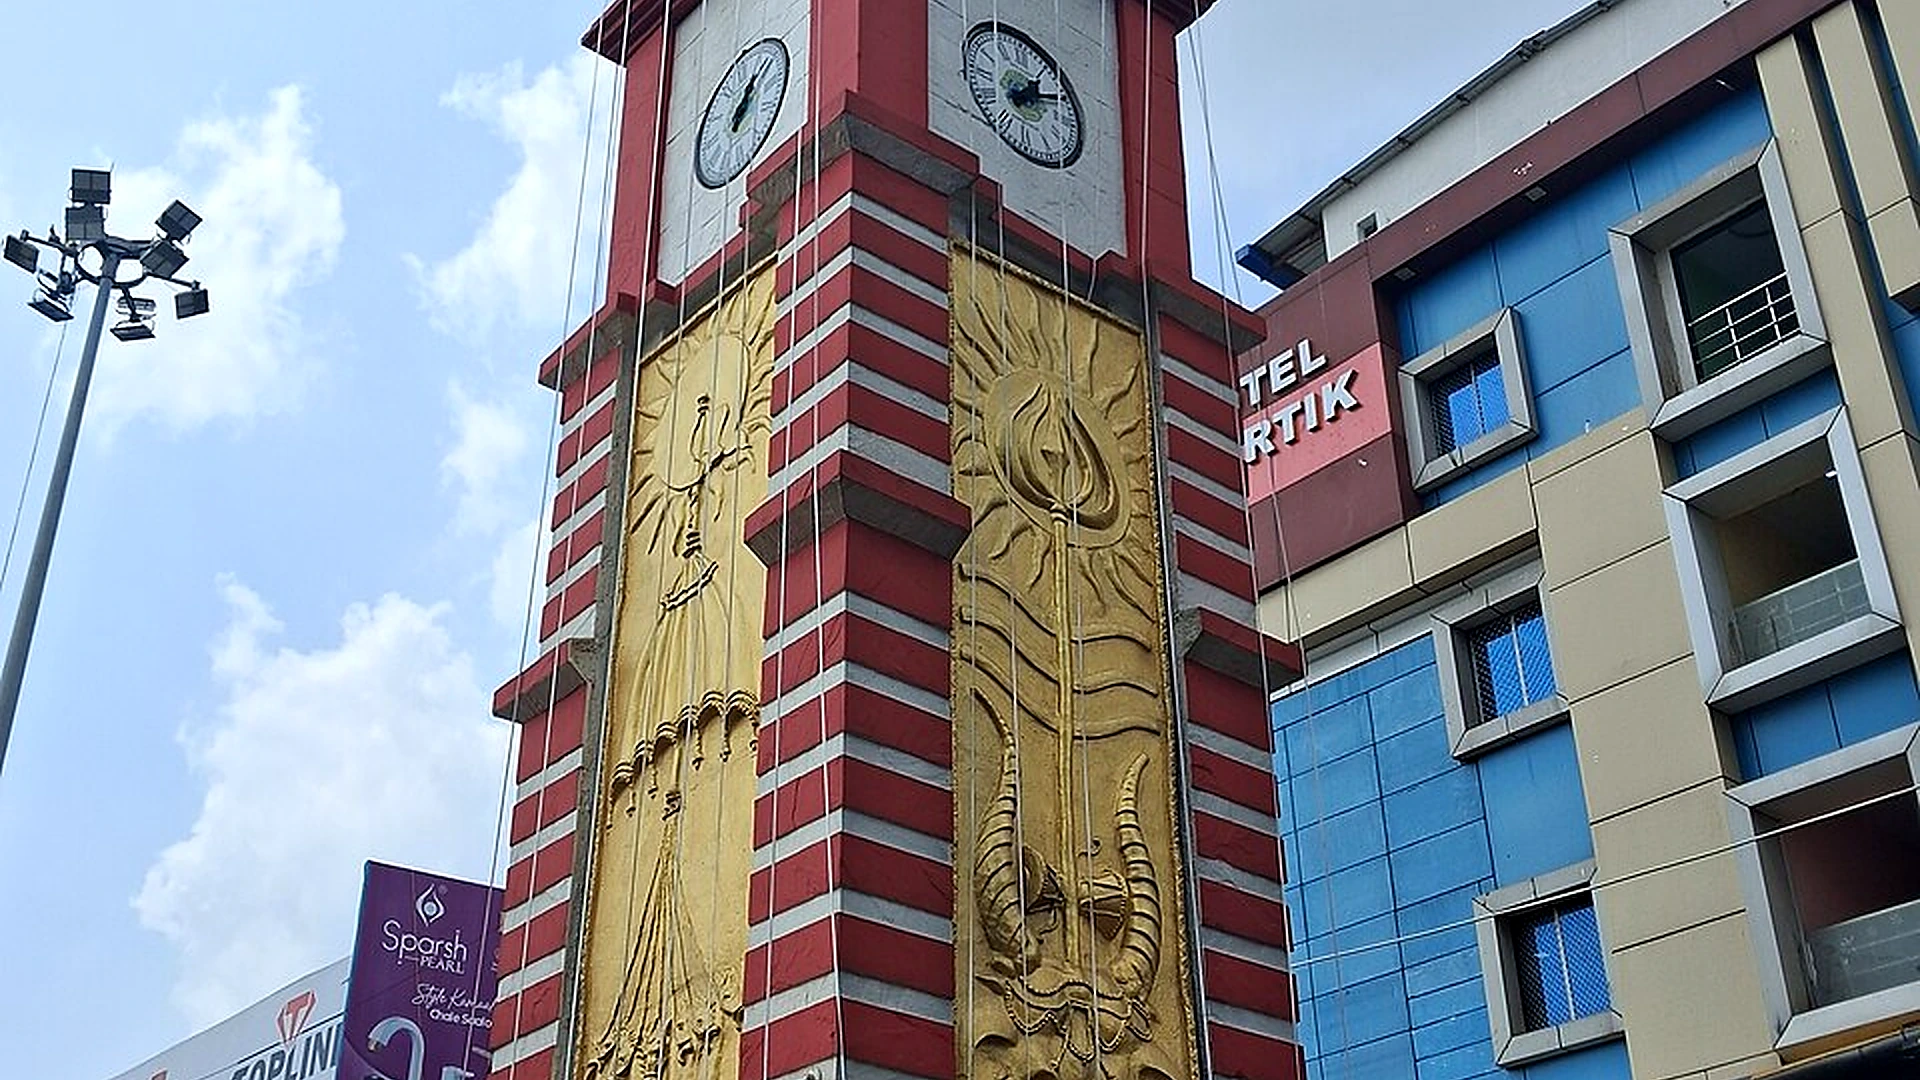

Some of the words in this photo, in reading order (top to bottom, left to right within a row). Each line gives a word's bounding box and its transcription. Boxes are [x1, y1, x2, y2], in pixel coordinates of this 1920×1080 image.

[1240, 338, 1327, 407] TEL
[1242, 368, 1359, 464] RTIK
[381, 919, 467, 965] Sparsh
[420, 955, 465, 975] PEARL
[411, 983, 447, 1009] Style
